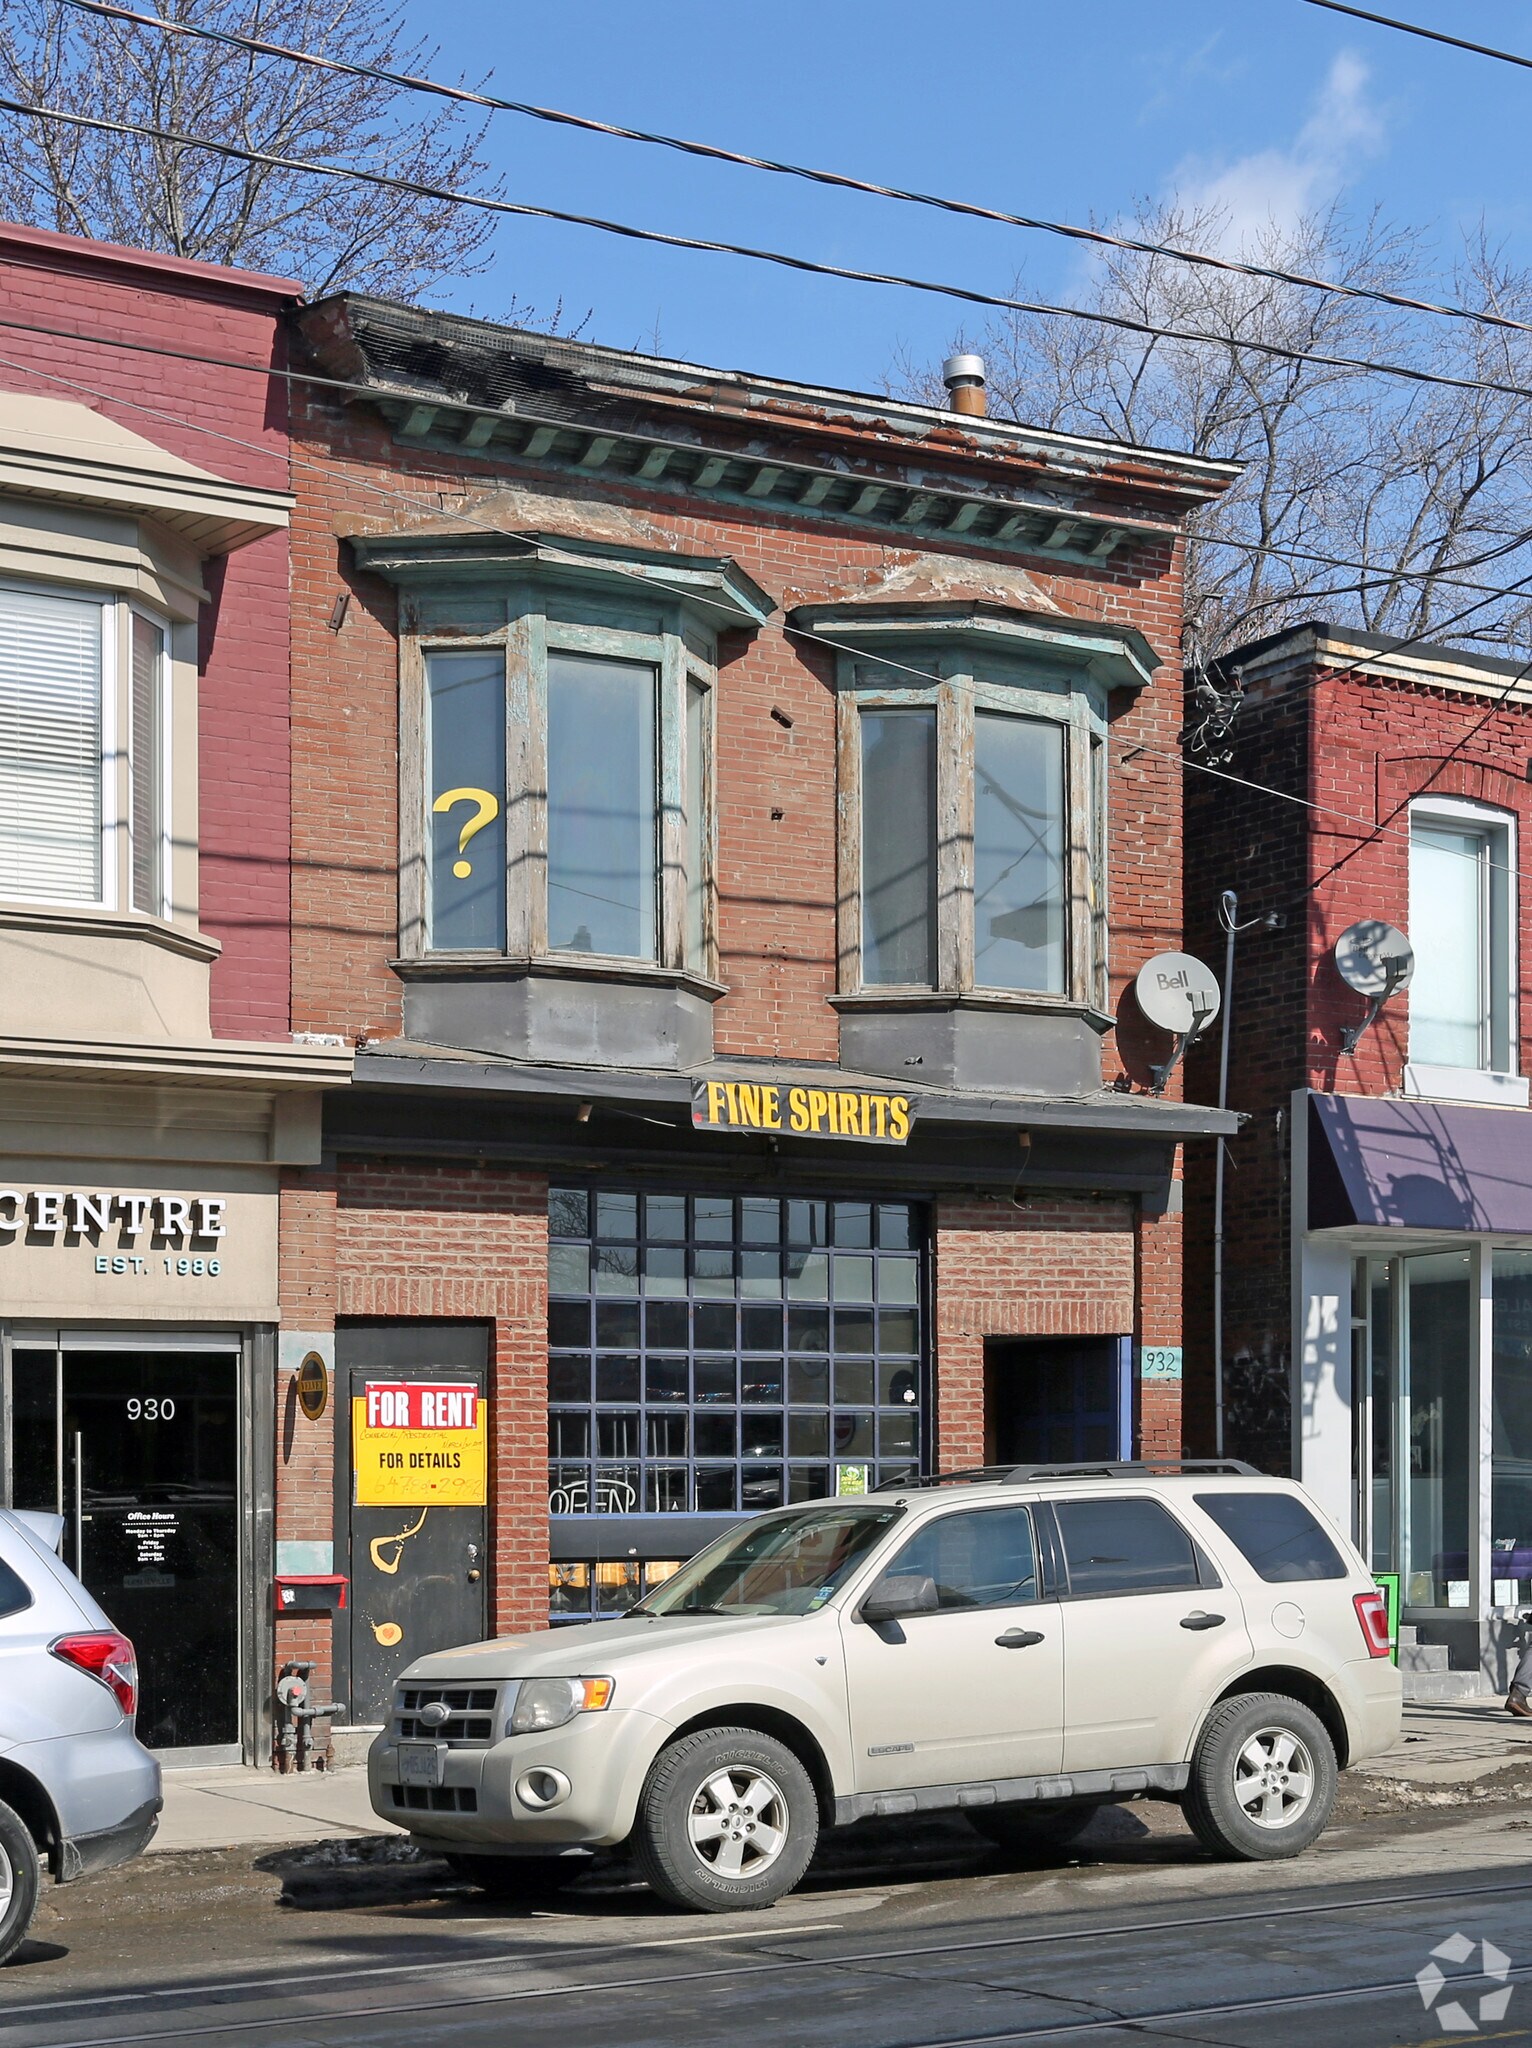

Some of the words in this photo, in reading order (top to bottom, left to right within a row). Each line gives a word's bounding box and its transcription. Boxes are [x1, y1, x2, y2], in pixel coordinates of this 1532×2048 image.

[1155, 970, 1189, 990] Bell
[707, 1081, 782, 1129] FINE
[788, 1088, 910, 1140] SPIRITS
[0, 1189, 228, 1238] CENTRE
[95, 1256, 150, 1275] EST.
[164, 1257, 222, 1276] 1986
[1145, 1351, 1177, 1372] 932
[126, 1398, 176, 1421] 930
[368, 1391, 410, 1427] FOR
[421, 1391, 475, 1427] RENT
[380, 1453, 404, 1468] FOR
[409, 1452, 461, 1468] DETAILS
[127, 1512, 151, 1520] Office
[151, 1512, 175, 1520] Hours
[715, 1749, 788, 1777] MICHELIN
[694, 1868, 769, 1894] MICHELIN
